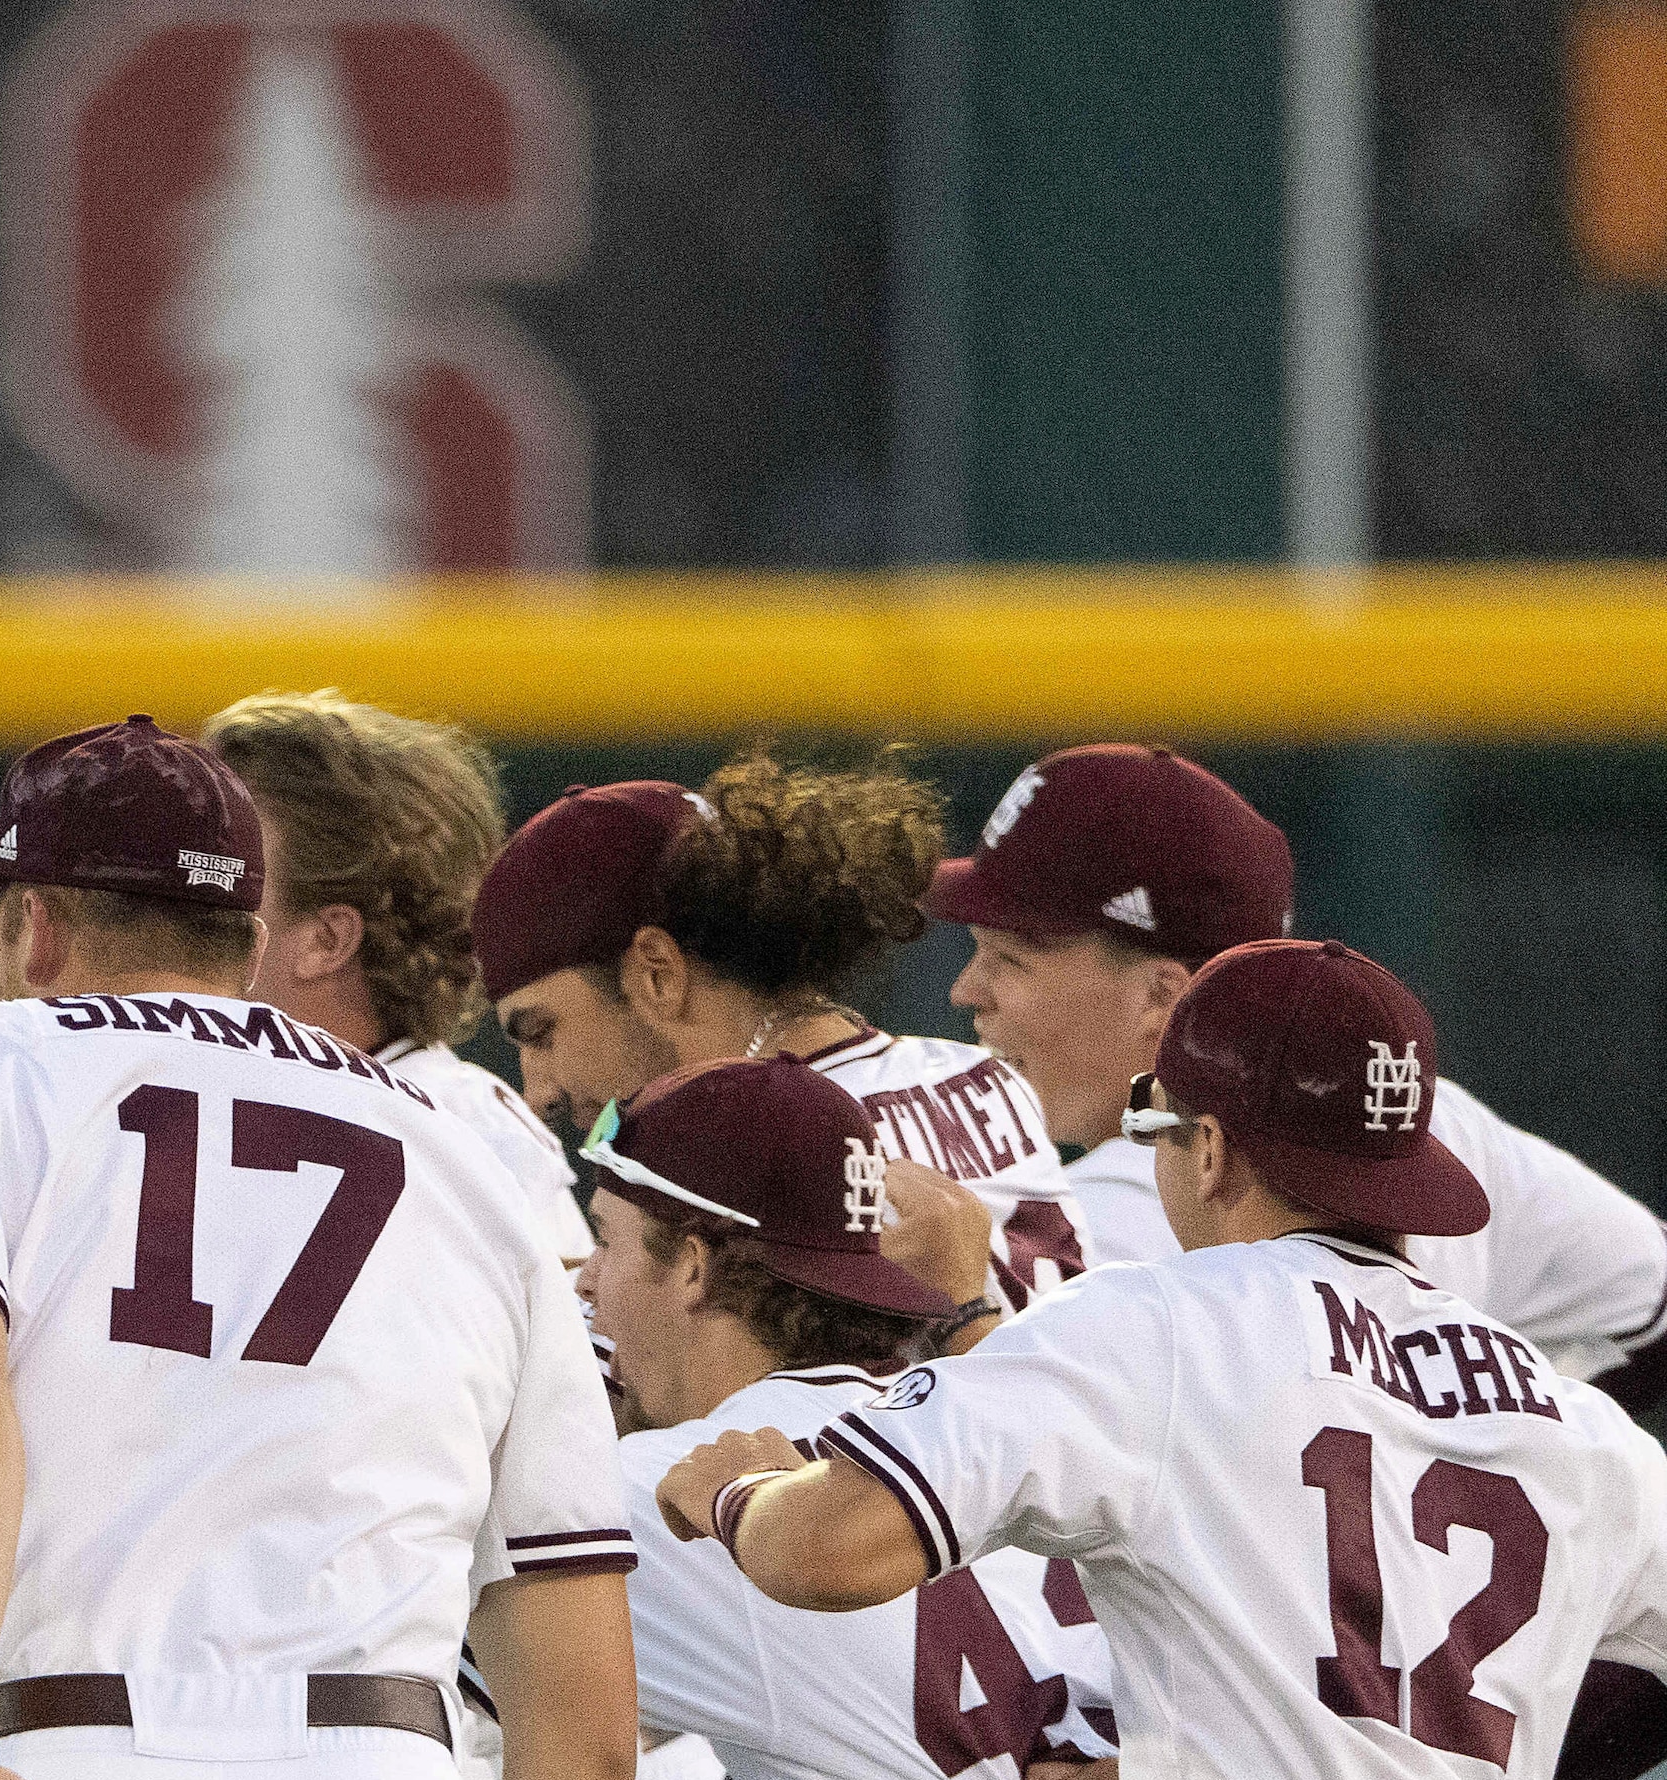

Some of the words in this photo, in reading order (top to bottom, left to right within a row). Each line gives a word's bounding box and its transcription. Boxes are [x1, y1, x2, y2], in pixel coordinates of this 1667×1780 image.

[177, 852, 245, 875] MISSISSIPPI
[109, 1083, 405, 1368] 17
[1300, 1426, 1551, 1775] 12
